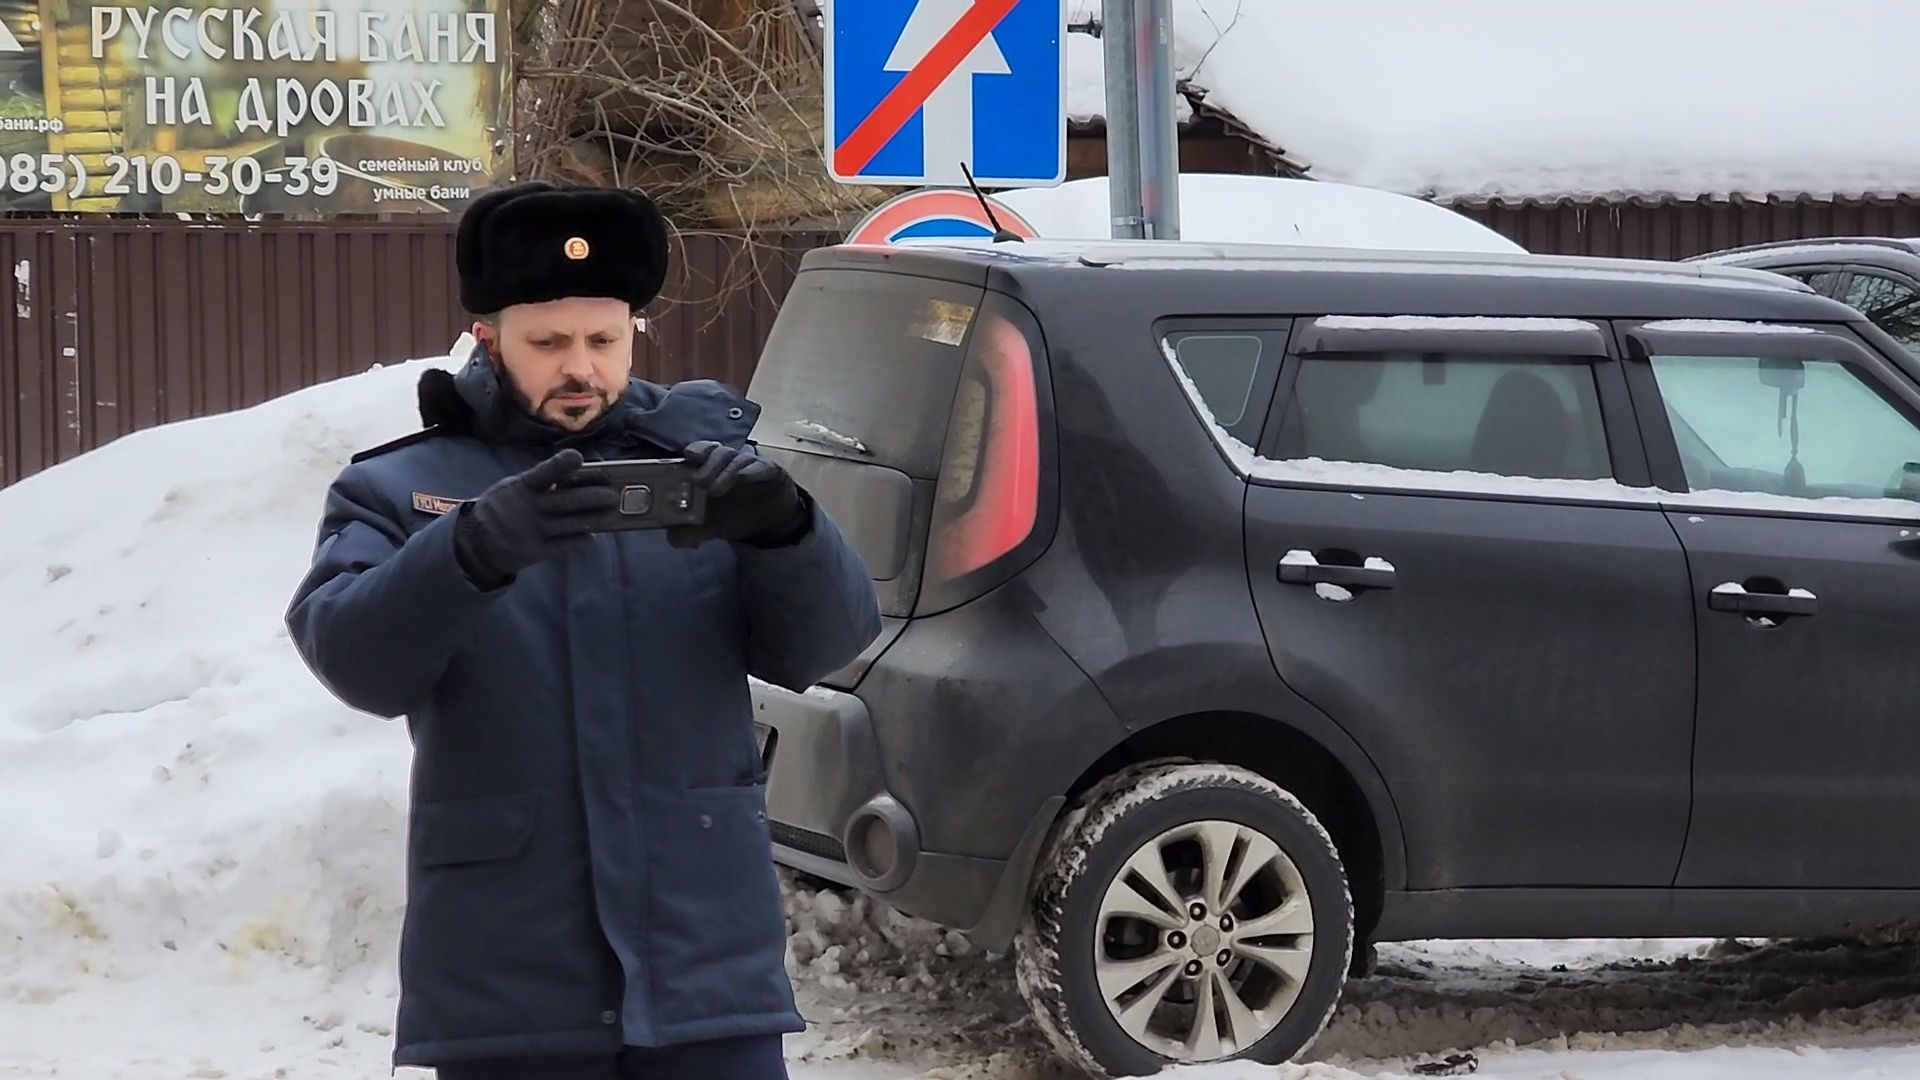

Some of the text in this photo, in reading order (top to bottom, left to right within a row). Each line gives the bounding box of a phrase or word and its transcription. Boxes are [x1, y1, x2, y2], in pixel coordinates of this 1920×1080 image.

[91, 6, 497, 63] РУССКАЯ БАНЯ
[145, 77, 446, 137] НА ДРОВАХ
[0, 152, 339, 199] 85) 210-30-39
[358, 156, 483, 174] семейный клуб
[373, 185, 470, 203] умные бани
